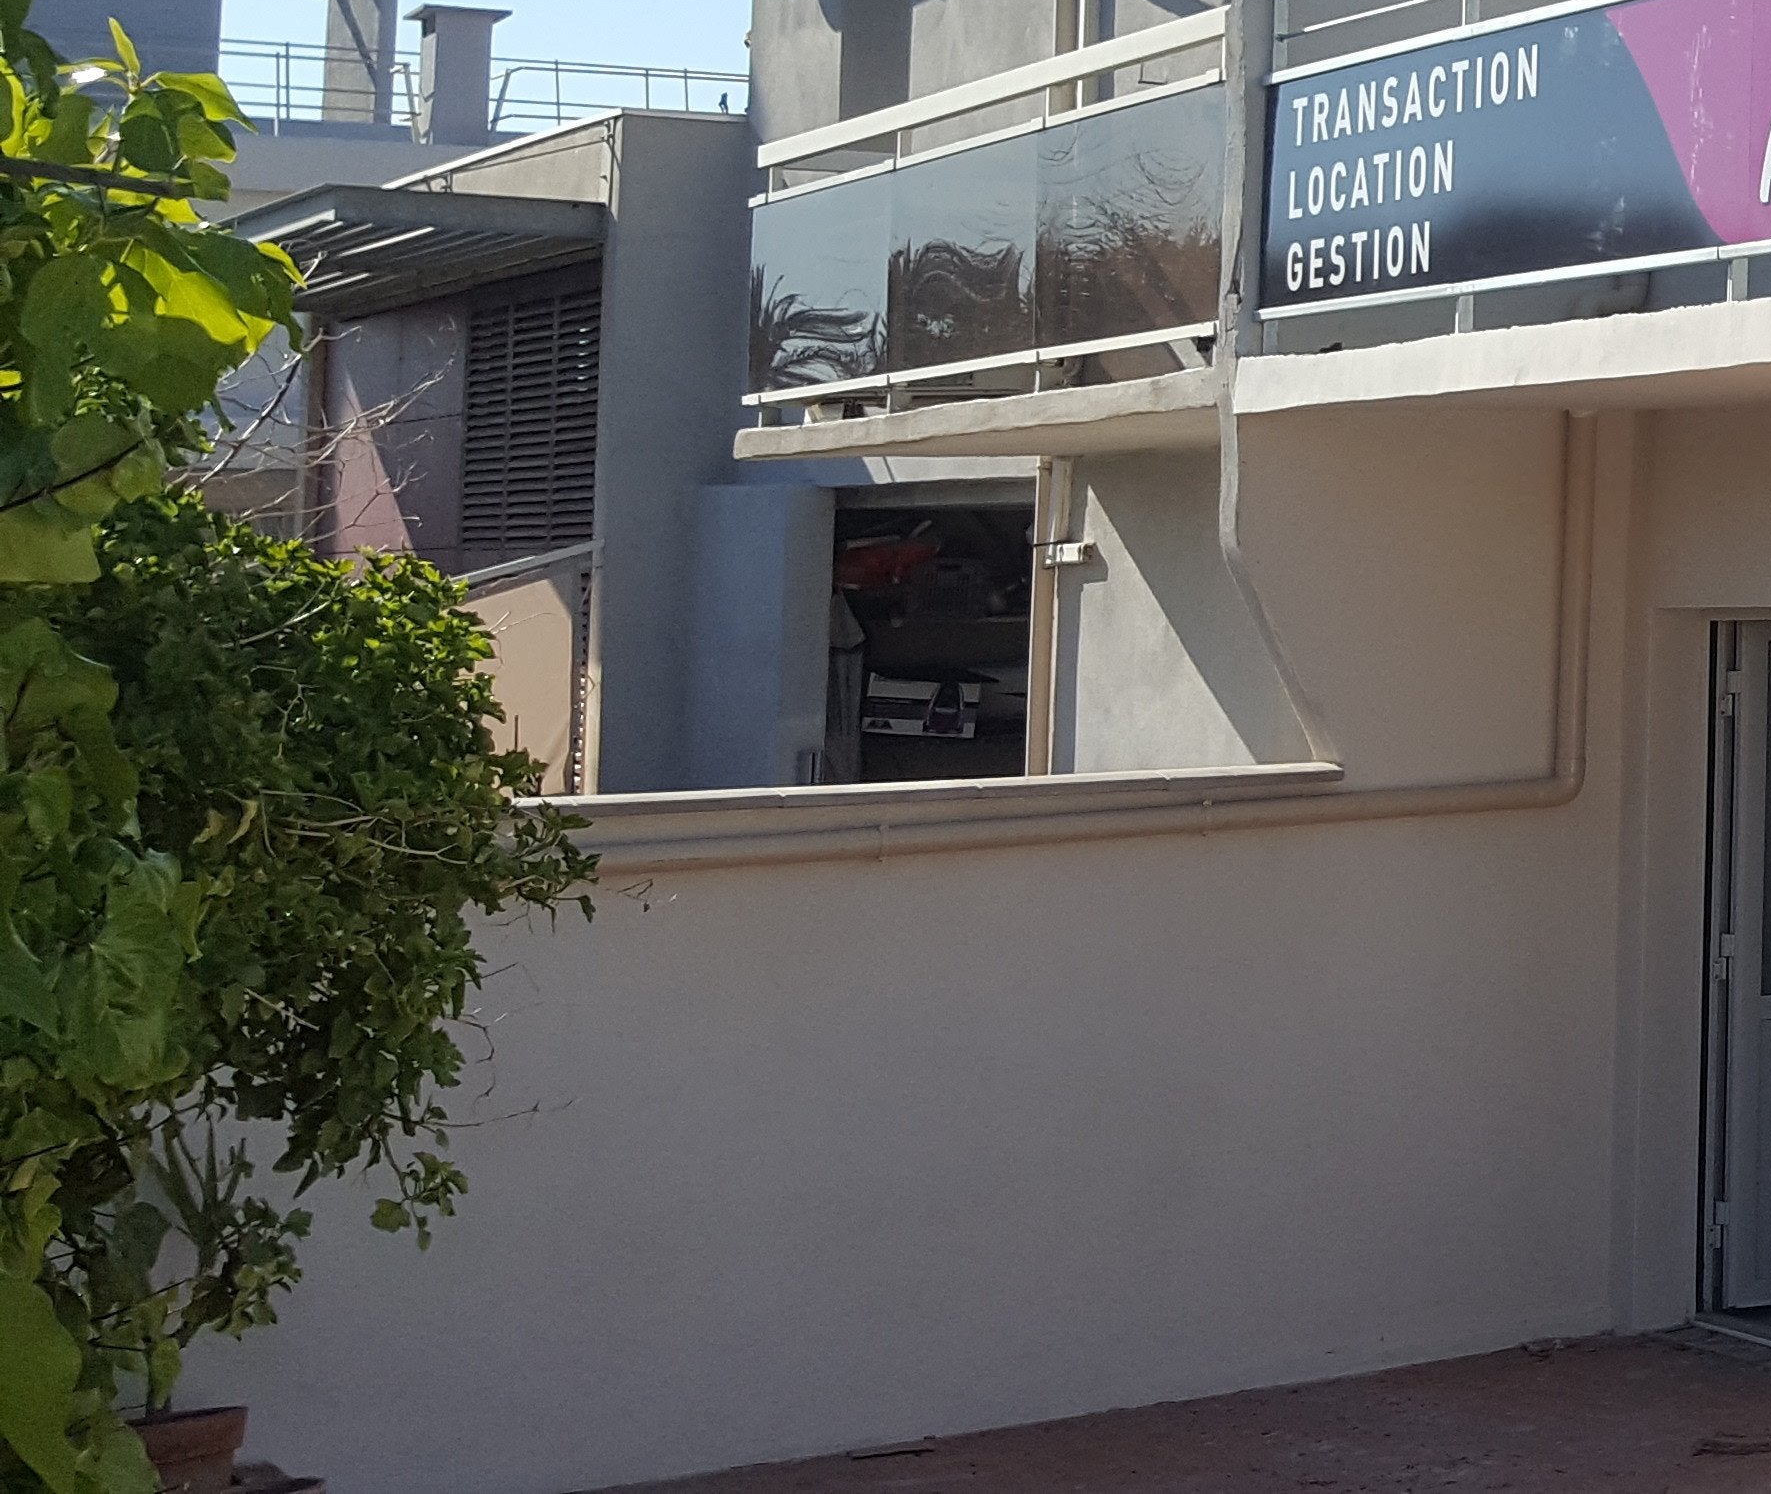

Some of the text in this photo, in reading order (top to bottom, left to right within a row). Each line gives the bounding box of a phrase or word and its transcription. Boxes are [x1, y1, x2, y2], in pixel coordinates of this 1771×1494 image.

[1291, 43, 1539, 148] TRANSACTION
[1287, 139, 1455, 220] LOCATION
[1286, 221, 1433, 294] GESTION
